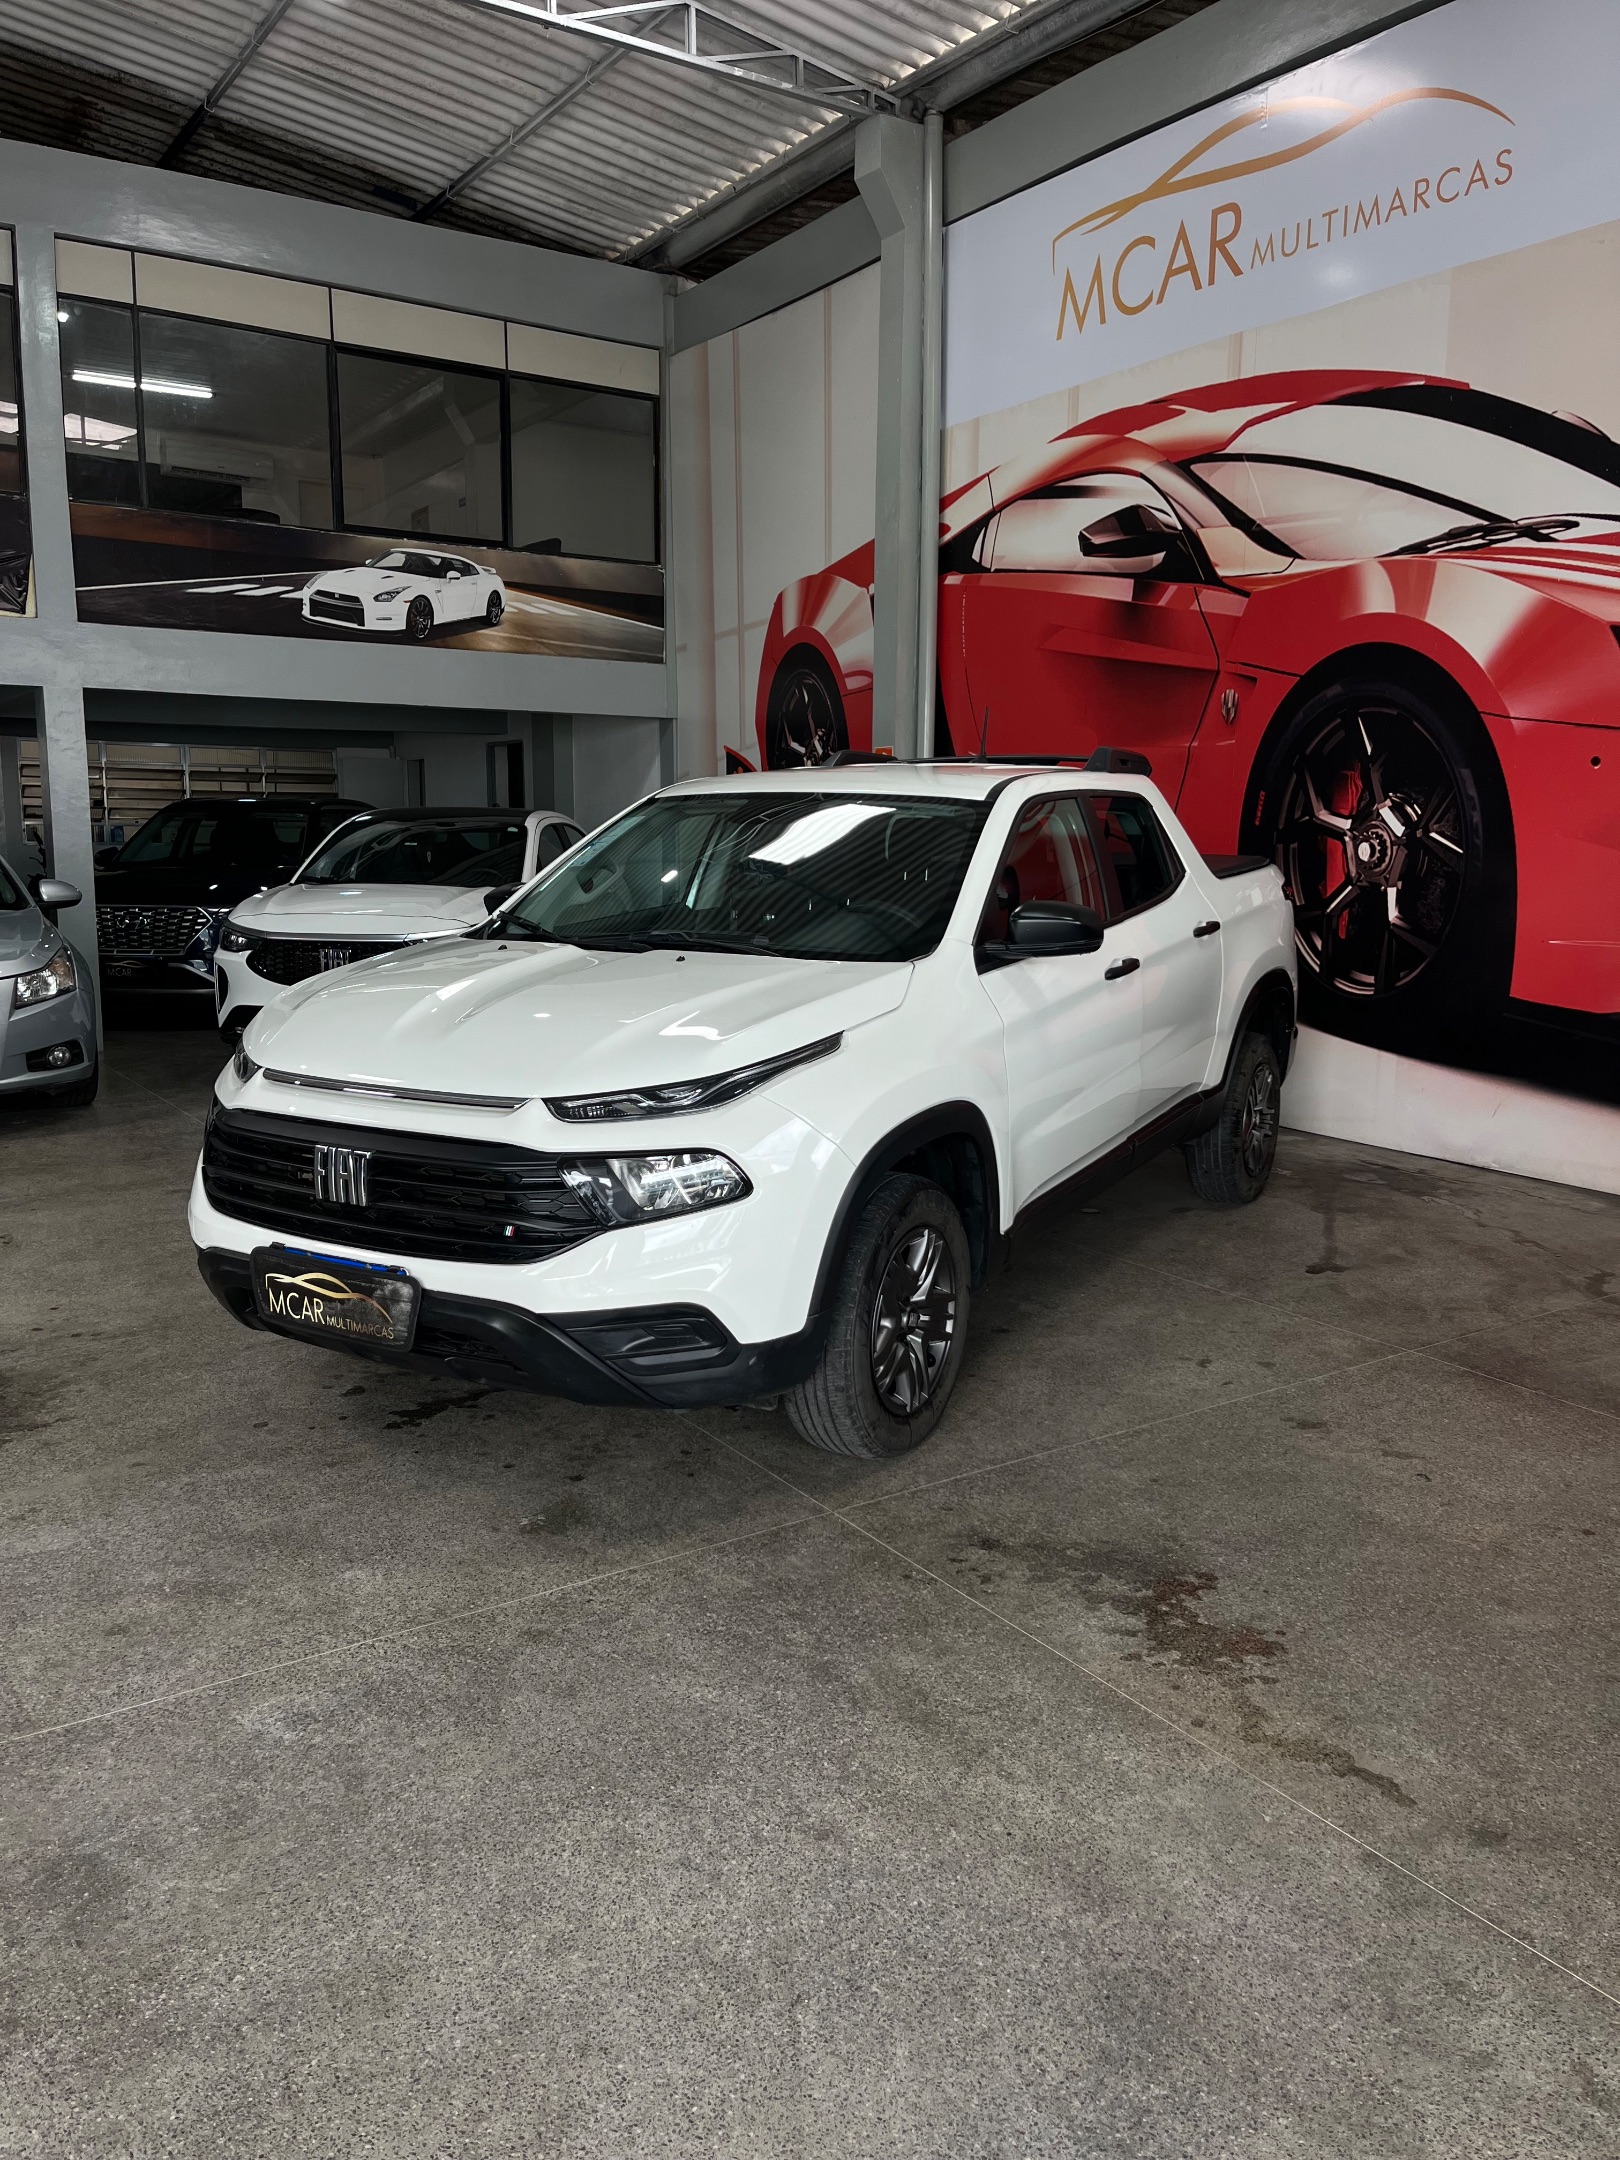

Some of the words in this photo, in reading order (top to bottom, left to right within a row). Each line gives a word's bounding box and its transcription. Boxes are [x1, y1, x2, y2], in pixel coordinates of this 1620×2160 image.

[1056, 201, 1245, 341] MCAR
[1250, 148, 1514, 270] MULTIMARCAS
[107, 967, 132, 977] MCAR
[320, 948, 352, 973] FIAT
[314, 1145, 371, 1207] FIAT
[268, 1287, 325, 1325] MCAR
[326, 1314, 394, 1340] MULTIMARCAS
